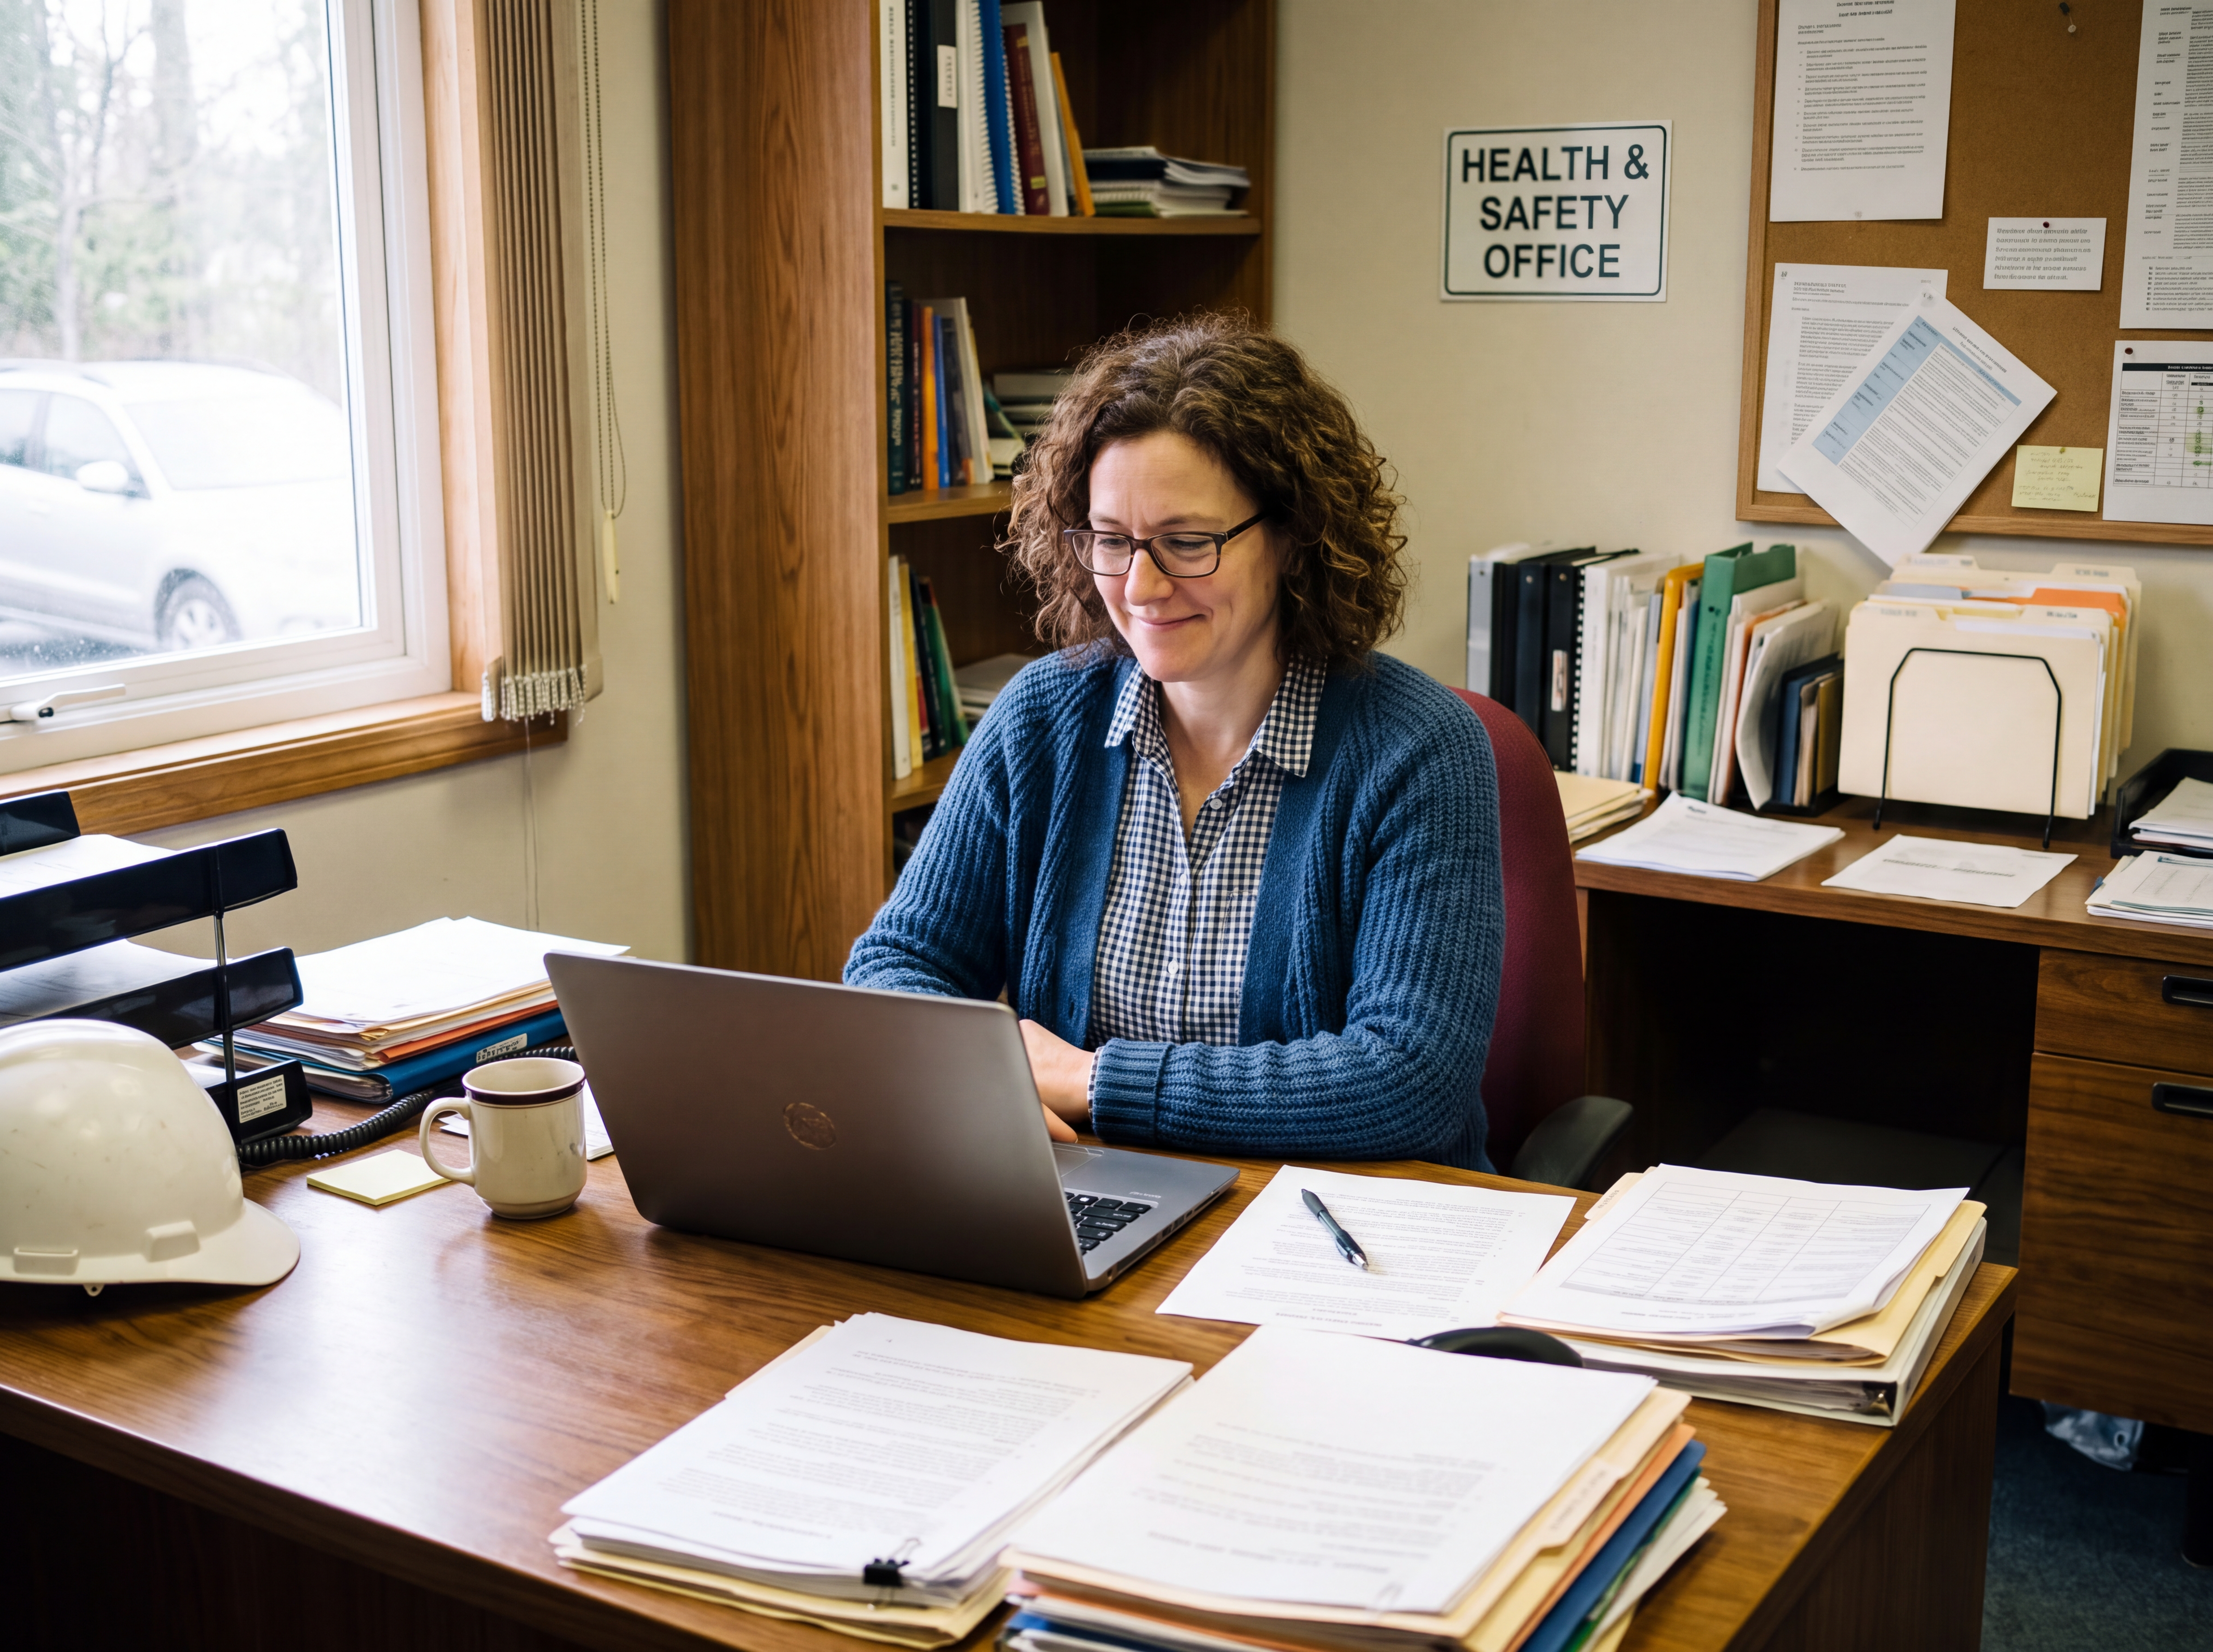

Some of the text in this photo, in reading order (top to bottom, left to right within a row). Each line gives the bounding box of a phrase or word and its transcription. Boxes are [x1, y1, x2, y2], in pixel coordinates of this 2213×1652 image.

[1462, 144, 1649, 183] HEALTH &
[1479, 195, 1629, 231] SAFETY
[1484, 244, 1620, 278] OFFICE
